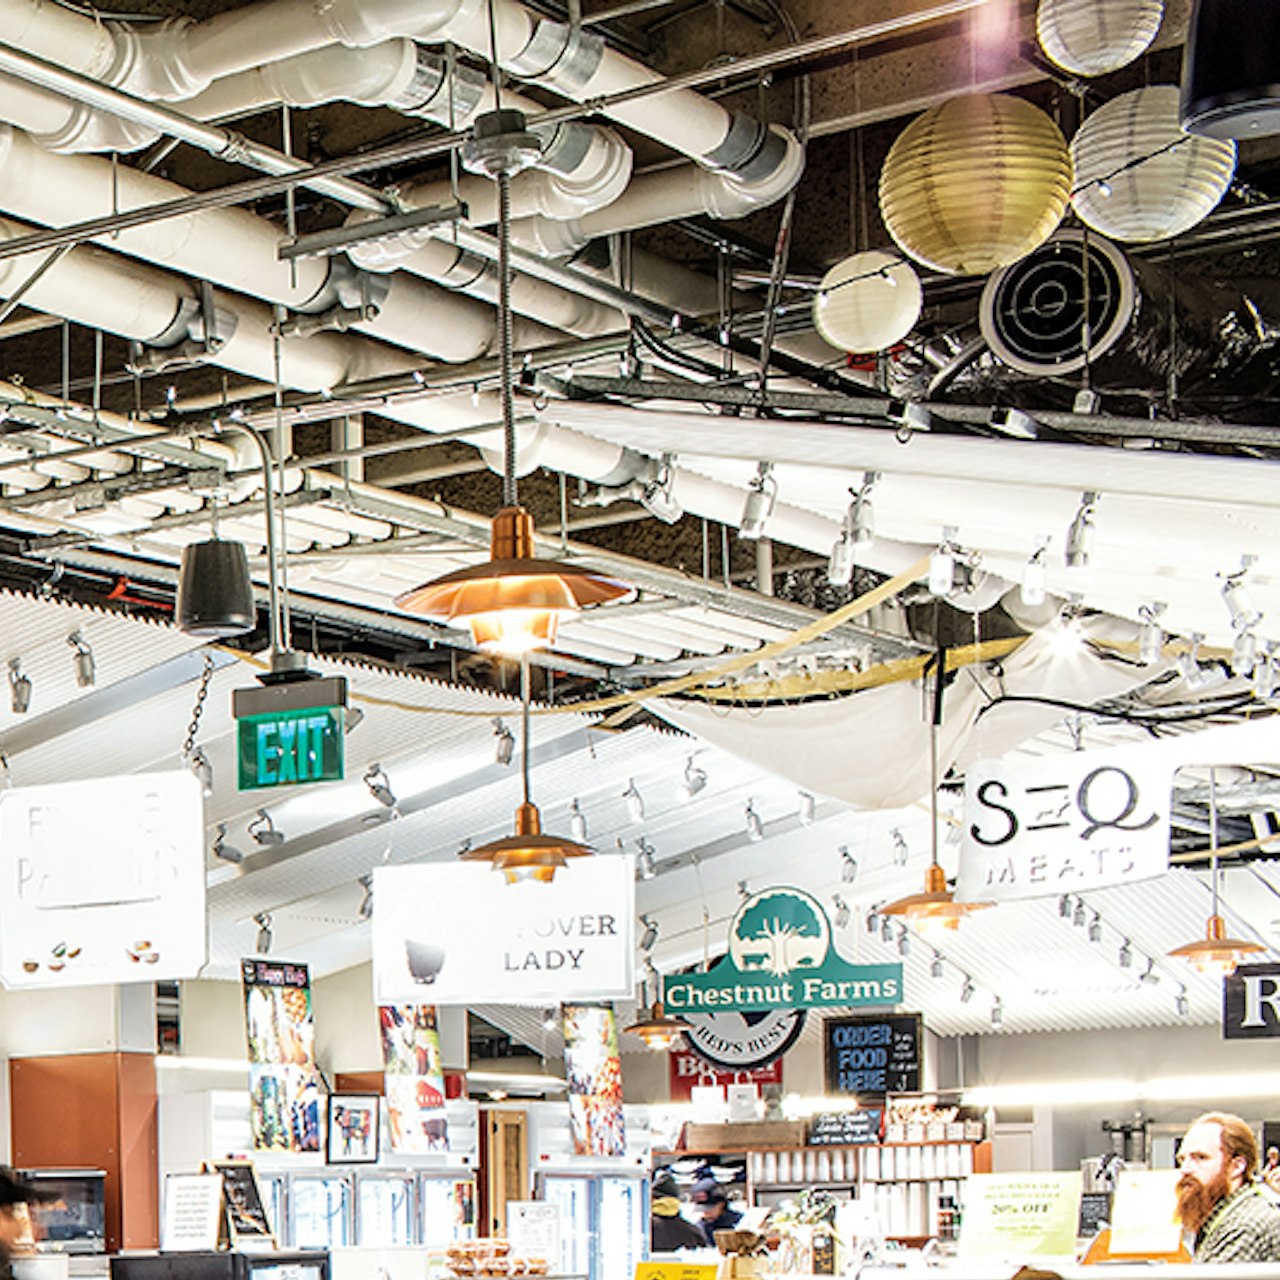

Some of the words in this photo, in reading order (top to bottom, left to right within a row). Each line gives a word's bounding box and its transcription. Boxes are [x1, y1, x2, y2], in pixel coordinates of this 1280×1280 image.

[257, 716, 328, 784] EXIT
[503, 949, 585, 972] LADY
[667, 980, 794, 1008] Chestnut
[802, 977, 898, 1002] Farms
[696, 1024, 743, 1054] RED'S
[747, 1018, 790, 1053] BEST
[833, 1023, 891, 1048] ORDER
[839, 1049, 887, 1069] FOOD
[840, 1069, 887, 1091] HERE
